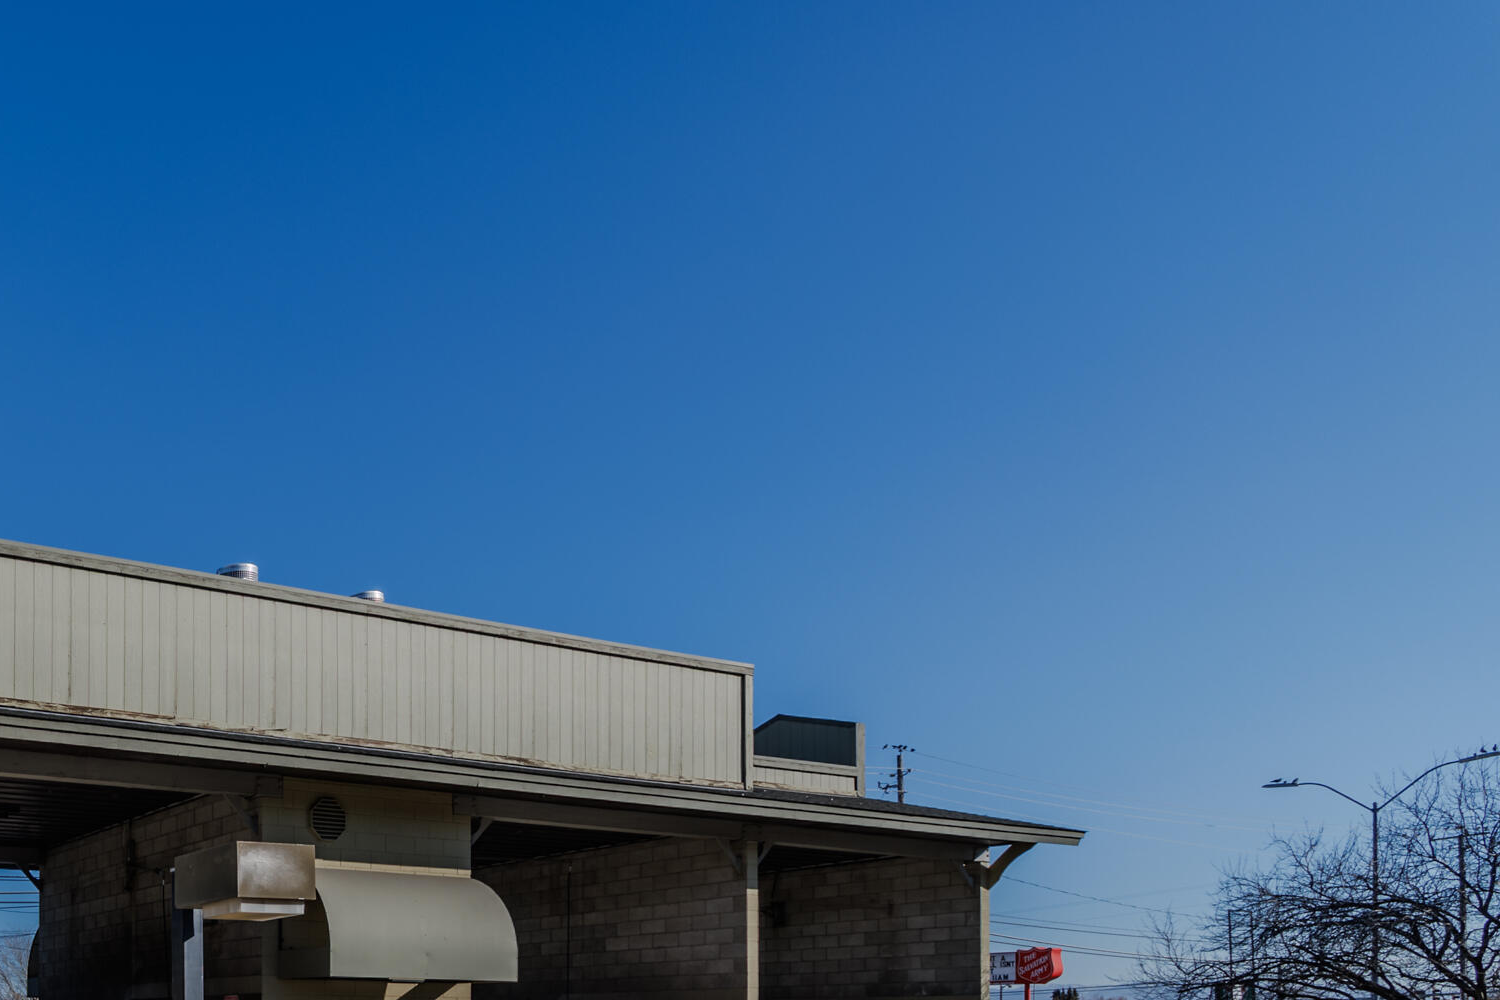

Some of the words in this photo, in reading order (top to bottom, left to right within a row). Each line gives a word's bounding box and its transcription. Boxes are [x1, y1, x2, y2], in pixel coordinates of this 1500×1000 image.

[1019, 955, 1049, 975] SALVATION
[1024, 952, 1037, 963] THE
[1030, 964, 1049, 979] ARMY
